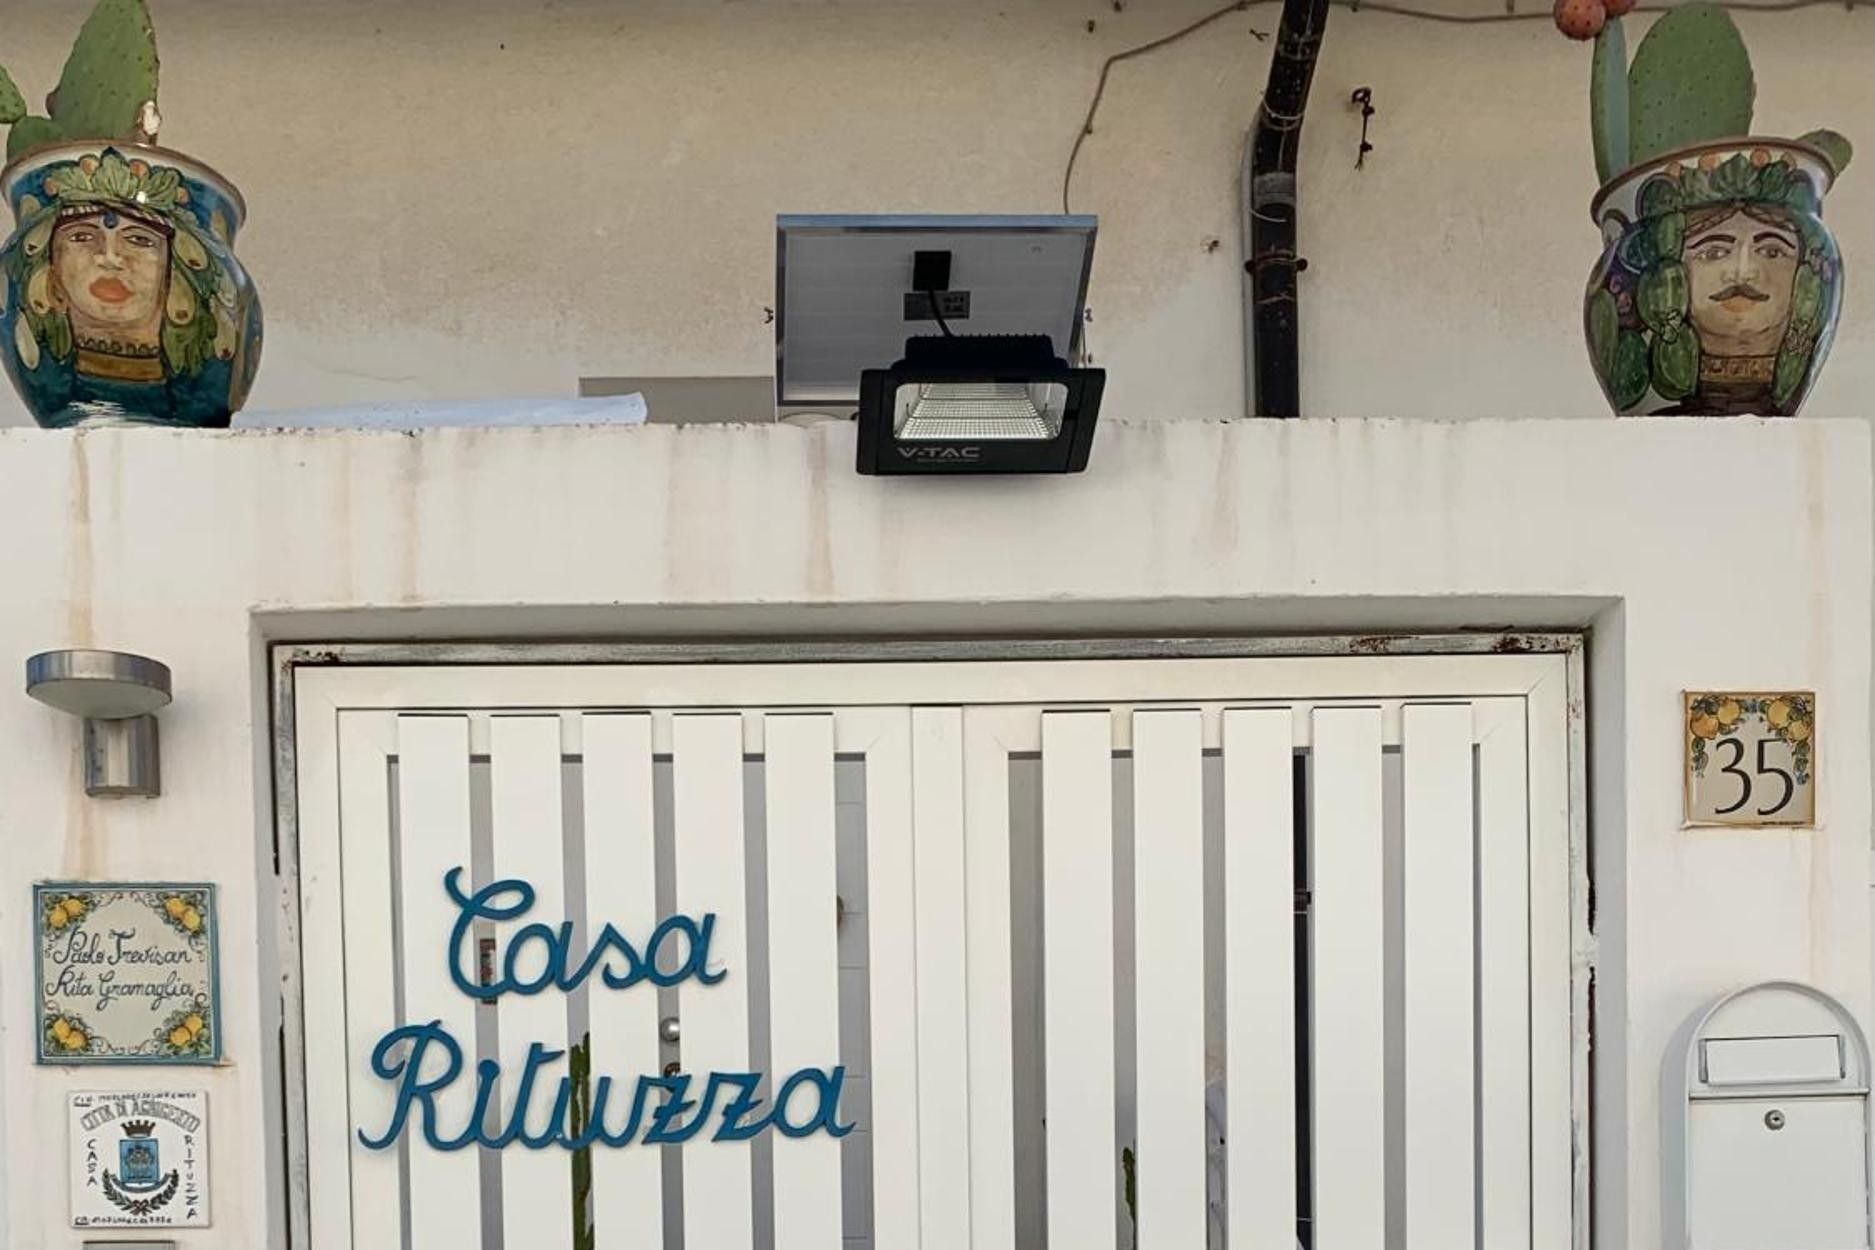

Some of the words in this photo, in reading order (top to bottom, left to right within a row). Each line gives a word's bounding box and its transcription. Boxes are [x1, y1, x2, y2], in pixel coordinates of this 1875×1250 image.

[897, 446, 981, 458] V-TAC
[1714, 737, 1794, 816] 35
[106, 927, 193, 966] Trevisan
[443, 866, 729, 1000] Casa
[45, 964, 93, 998] Rita
[95, 970, 194, 1012] Gramaglia
[357, 1019, 857, 1151] Rituzza
[86, 1138, 99, 1187] CASA
[183, 1134, 199, 1220] RITUZZA
